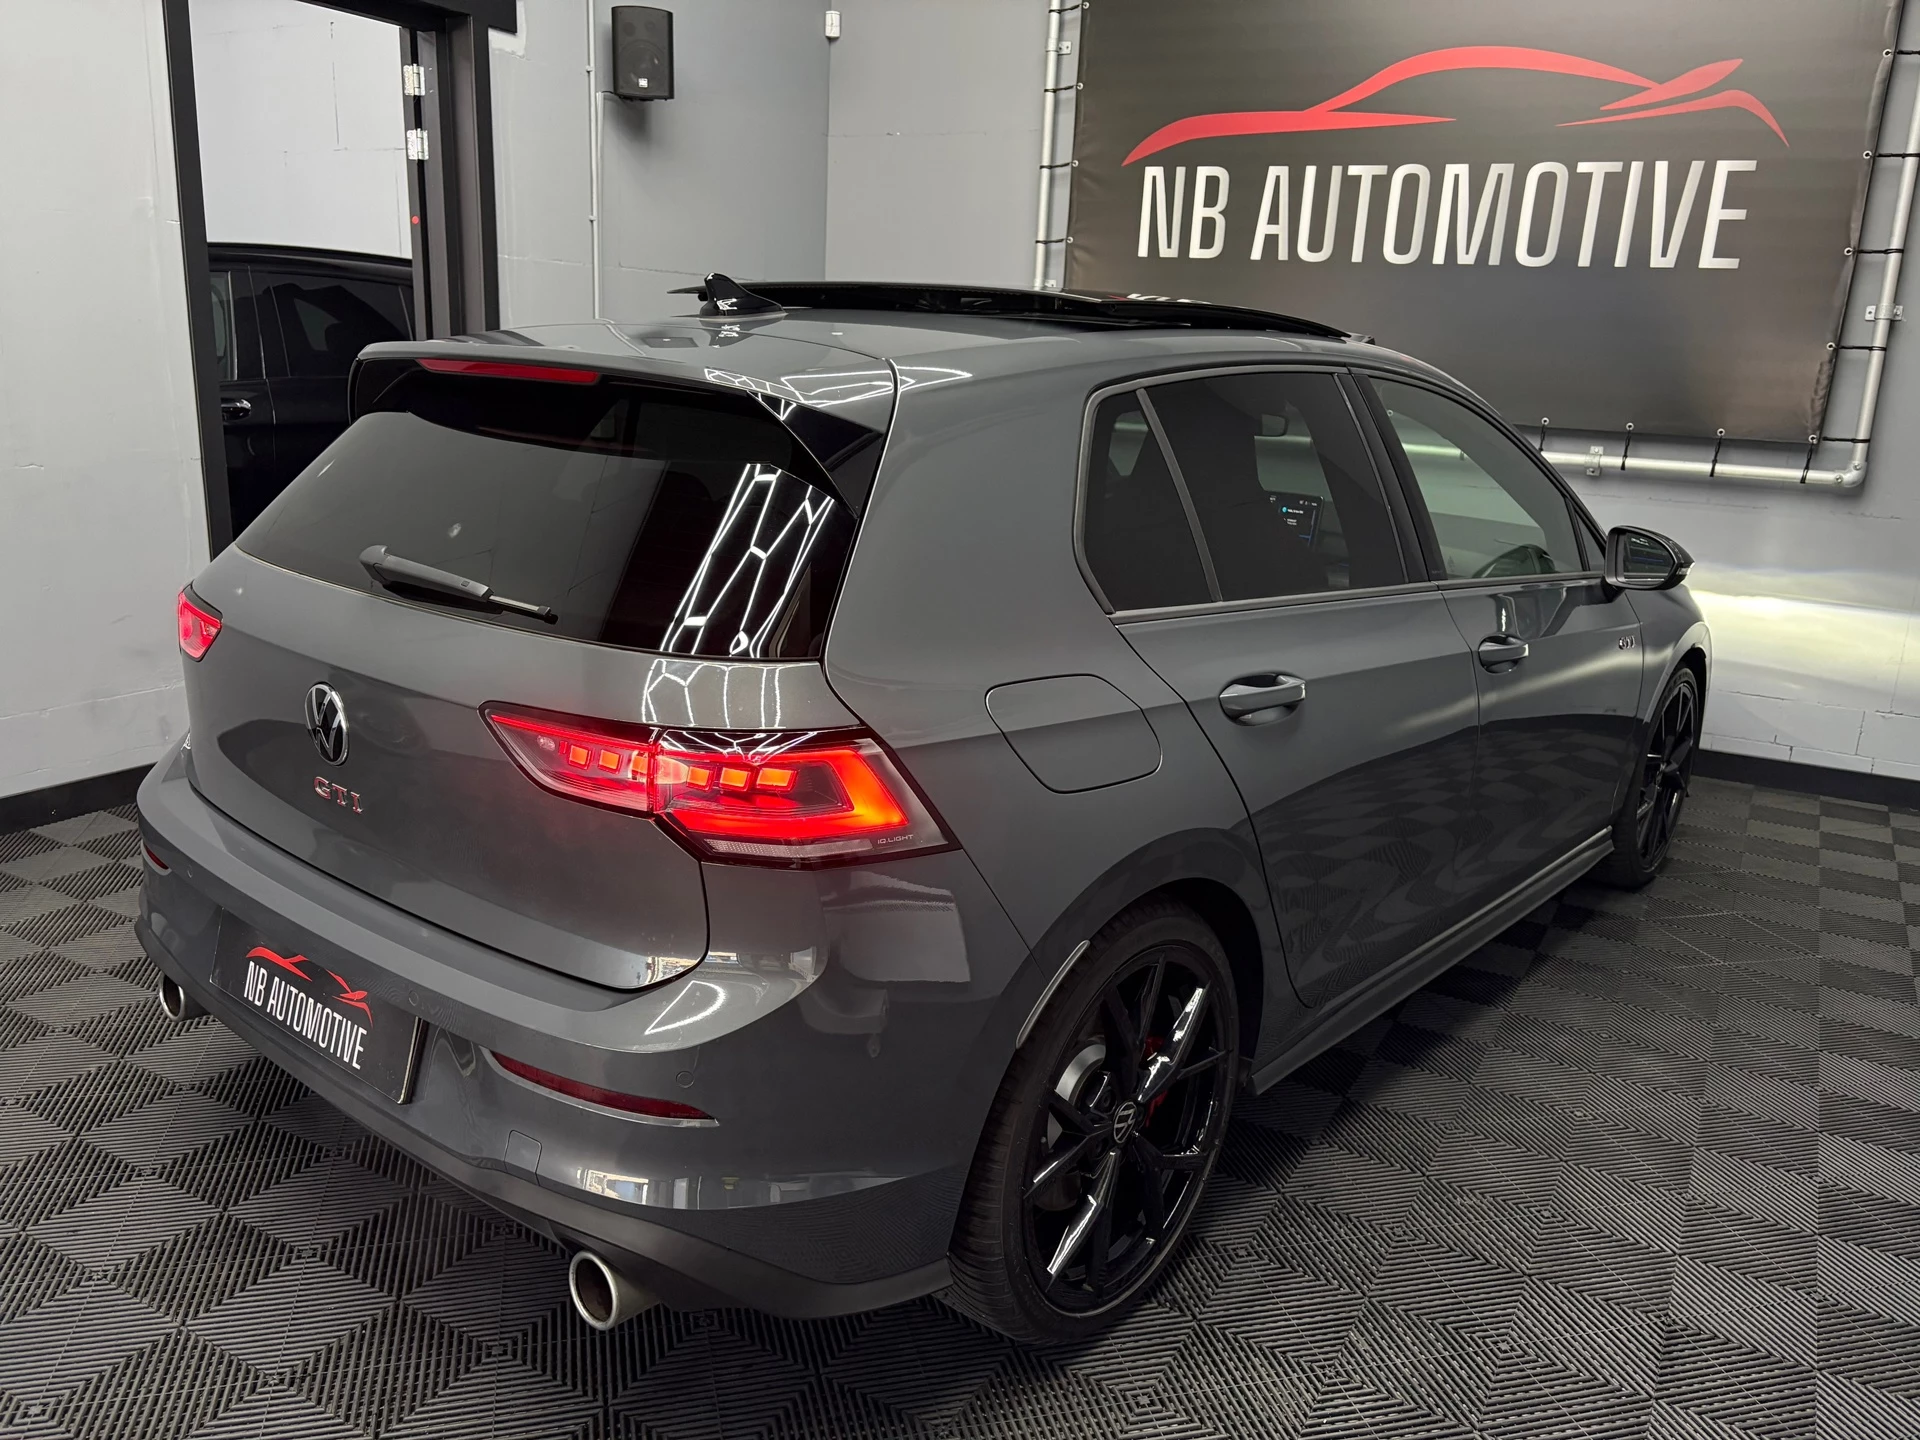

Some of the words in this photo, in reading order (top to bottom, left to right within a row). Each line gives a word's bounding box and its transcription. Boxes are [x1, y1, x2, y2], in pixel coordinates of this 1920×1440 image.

[1137, 164, 1230, 260] NB
[1250, 159, 1757, 269] AUTOMOTIVE
[313, 776, 364, 815] GTI
[877, 834, 914, 845] IQ.LIGHT
[243, 960, 268, 1007] NB
[266, 976, 368, 1070] AUTOMOTIVE
